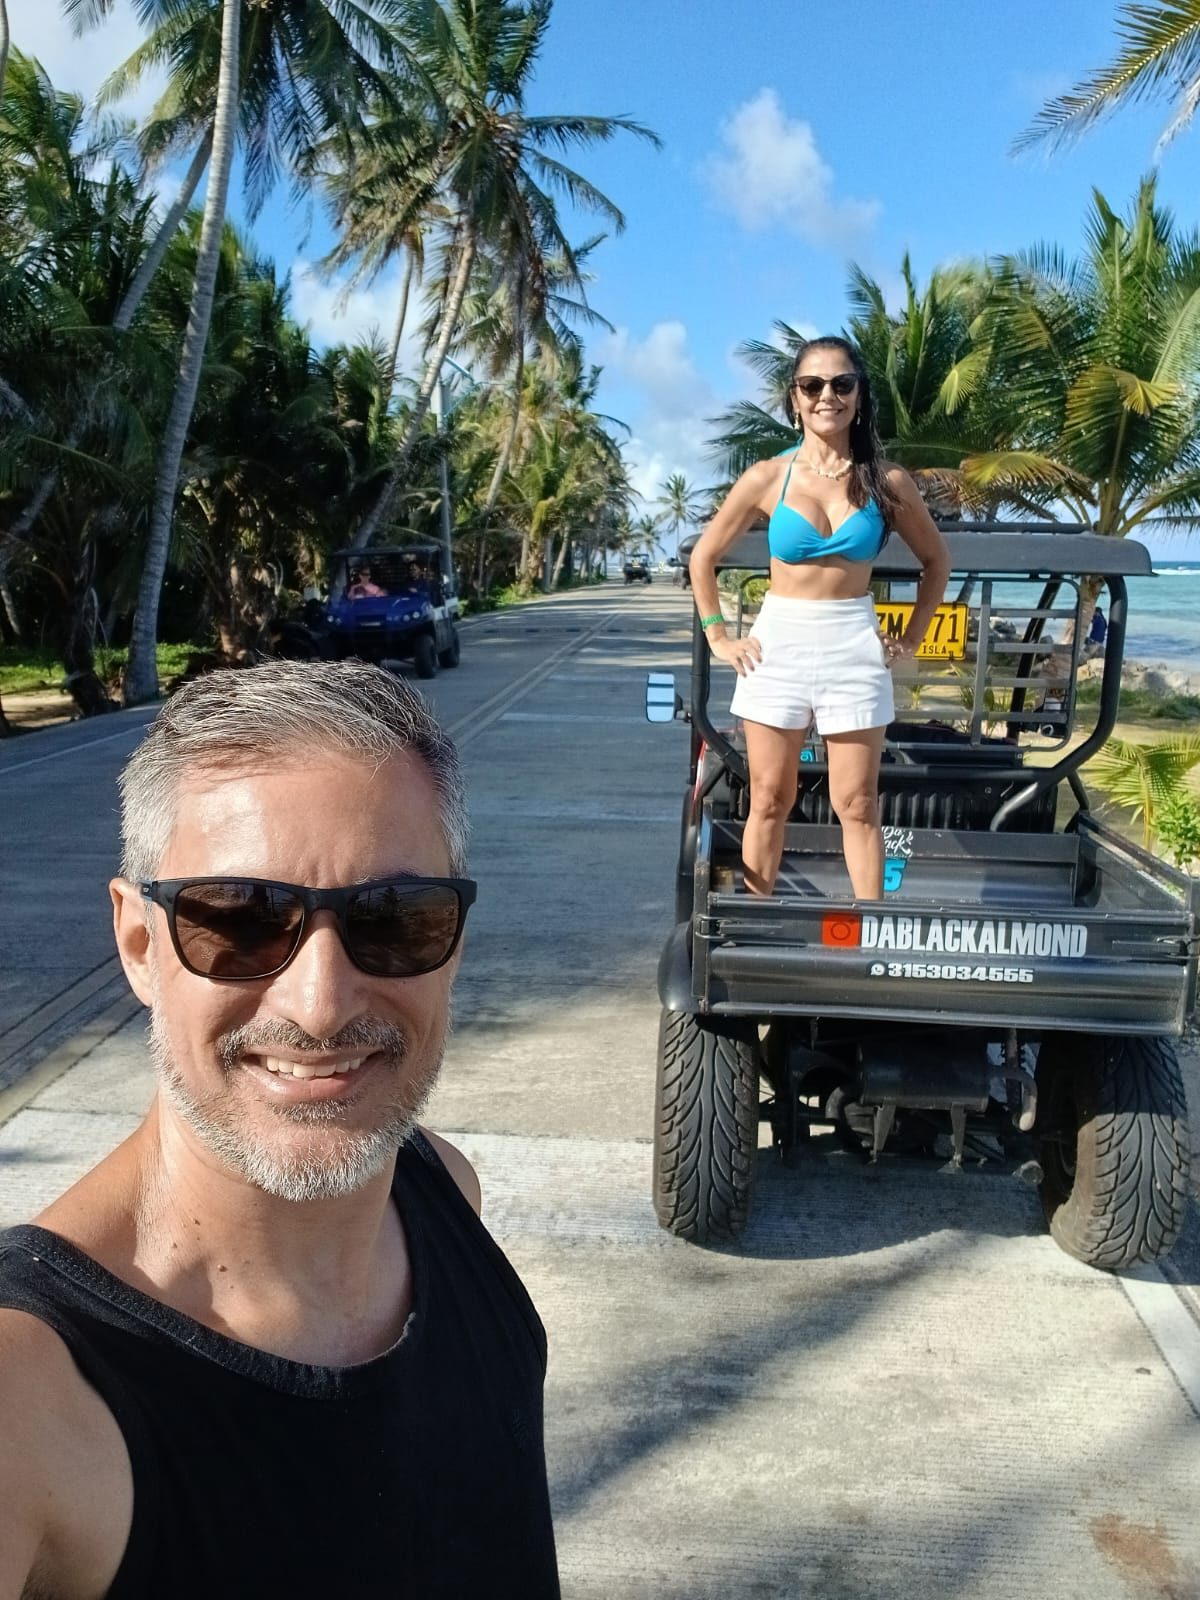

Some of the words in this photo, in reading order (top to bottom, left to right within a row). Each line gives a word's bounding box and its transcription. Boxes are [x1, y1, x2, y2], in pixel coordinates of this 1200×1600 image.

[922, 645, 947, 654] ISLA
[861, 915, 1088, 957] DABLACKALMOND
[888, 963, 1034, 983] 3153034555
